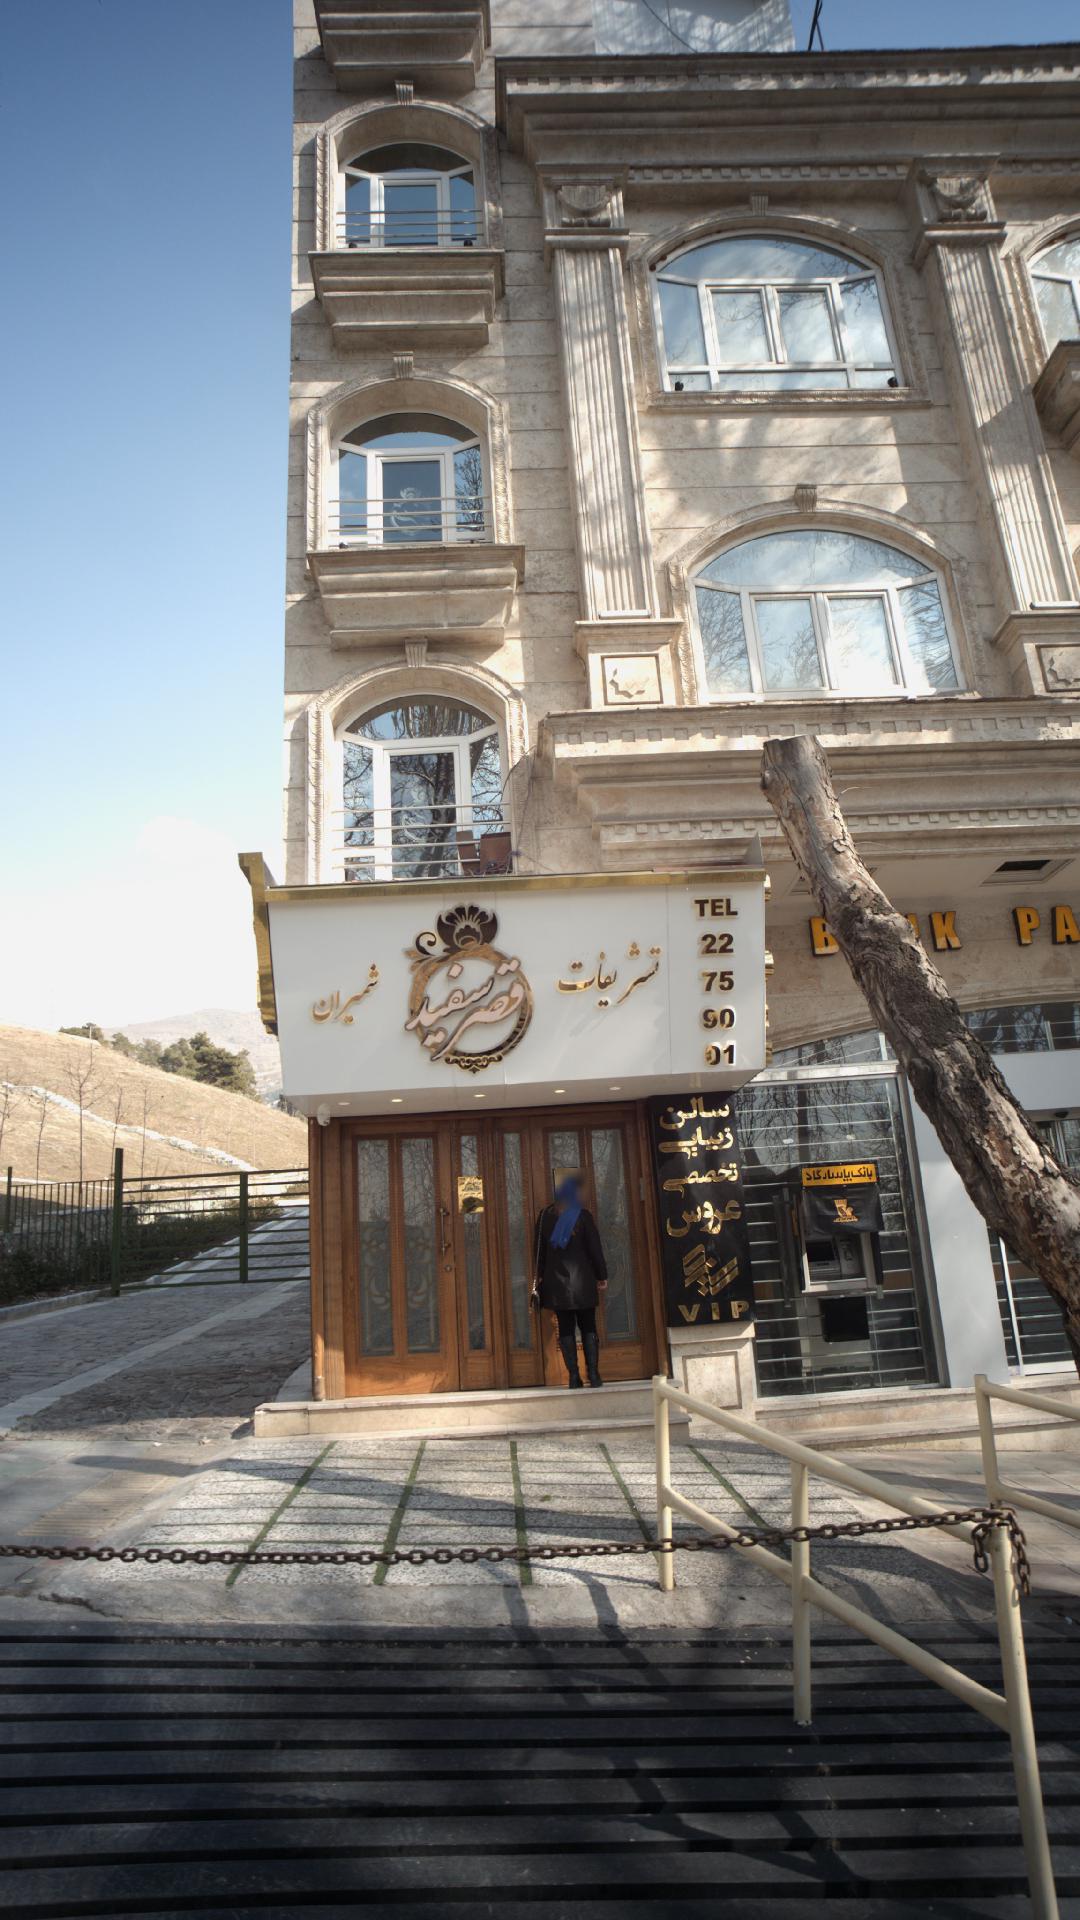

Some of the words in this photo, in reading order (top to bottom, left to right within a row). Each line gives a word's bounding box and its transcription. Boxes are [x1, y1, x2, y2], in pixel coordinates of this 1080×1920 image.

[694, 898, 738, 917] TEL
[700, 932, 734, 955] 22
[809, 910, 962, 957] BK
[558, 942, 661, 1007] تشریفات
[702, 970, 735, 992] 75
[311, 963, 379, 1024] شمیران
[404, 962, 495, 1048] سفید
[430, 957, 526, 1062] قصر
[702, 1007, 736, 1030] 90
[704, 1042, 736, 1066] 01
[660, 1096, 730, 1130] سالن
[662, 1162, 739, 1198] تخصصی
[806, 1168, 852, 1182] پاسارگاد
[851, 1166, 873, 1180] بانک
[666, 1200, 742, 1238] عروس
[678, 1300, 749, 1323] VIP
